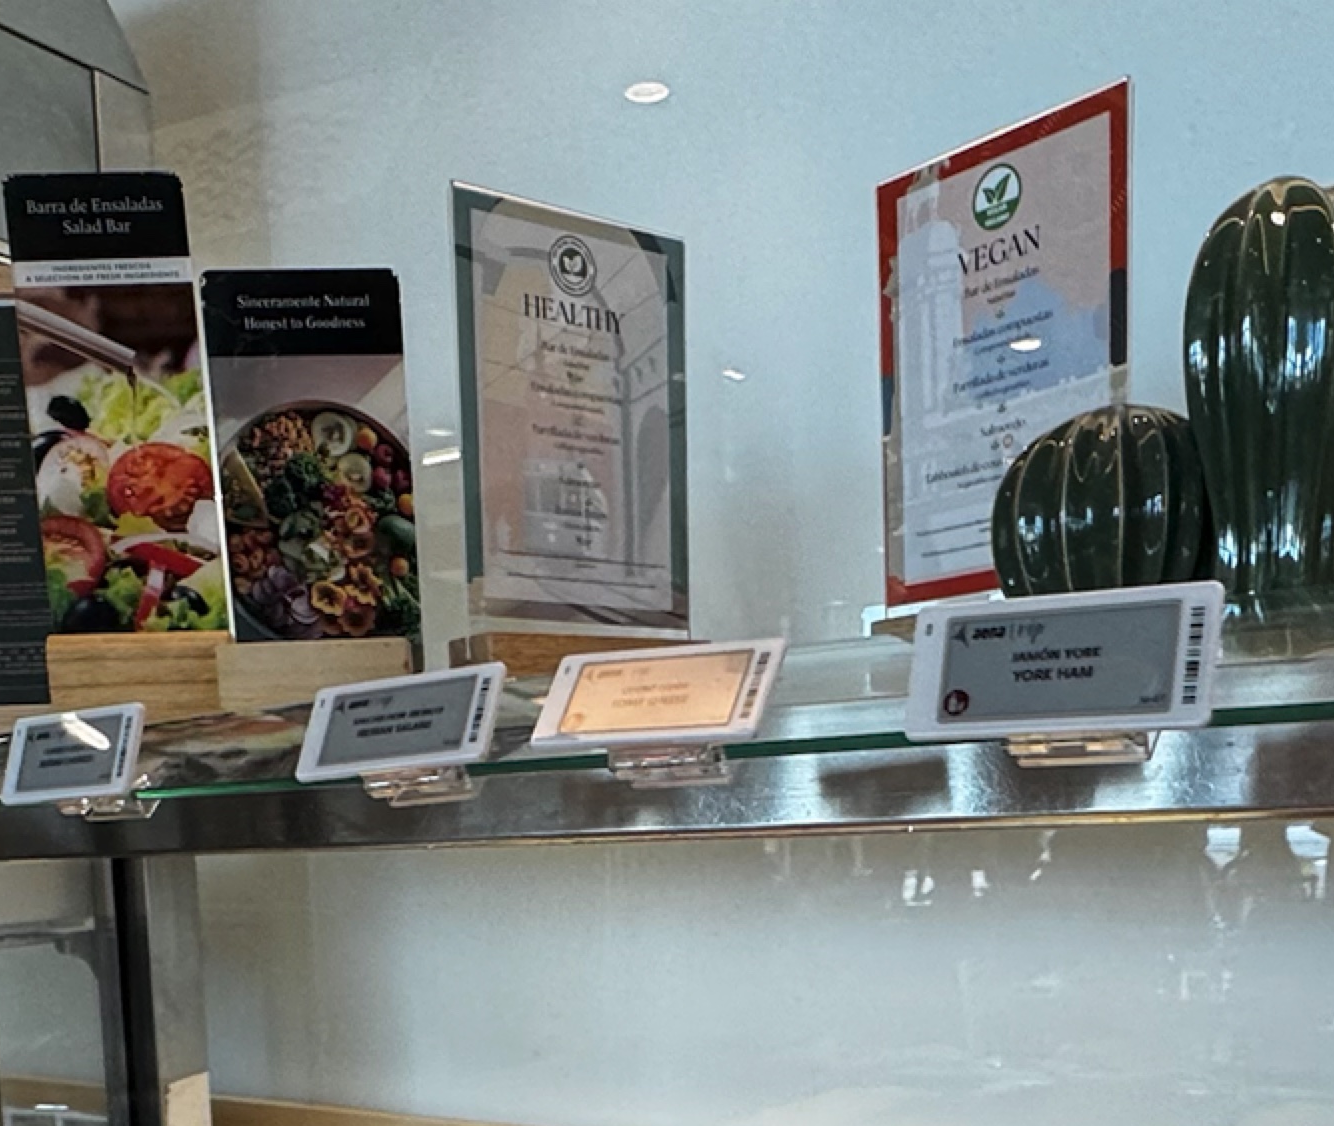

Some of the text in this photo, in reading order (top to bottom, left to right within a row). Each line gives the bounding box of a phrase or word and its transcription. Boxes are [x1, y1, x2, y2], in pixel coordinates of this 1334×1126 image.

[25, 196, 164, 215] Barra de Ensaladas
[62, 217, 132, 235] Salad Bar
[957, 223, 1041, 276] VEGAN
[322, 293, 370, 307] Natural
[244, 314, 366, 331] Honest to Goodness
[524, 293, 626, 335] HEALTHY
[1012, 646, 1061, 664] JAMÓN
[1013, 664, 1095, 684] YORK HAM
